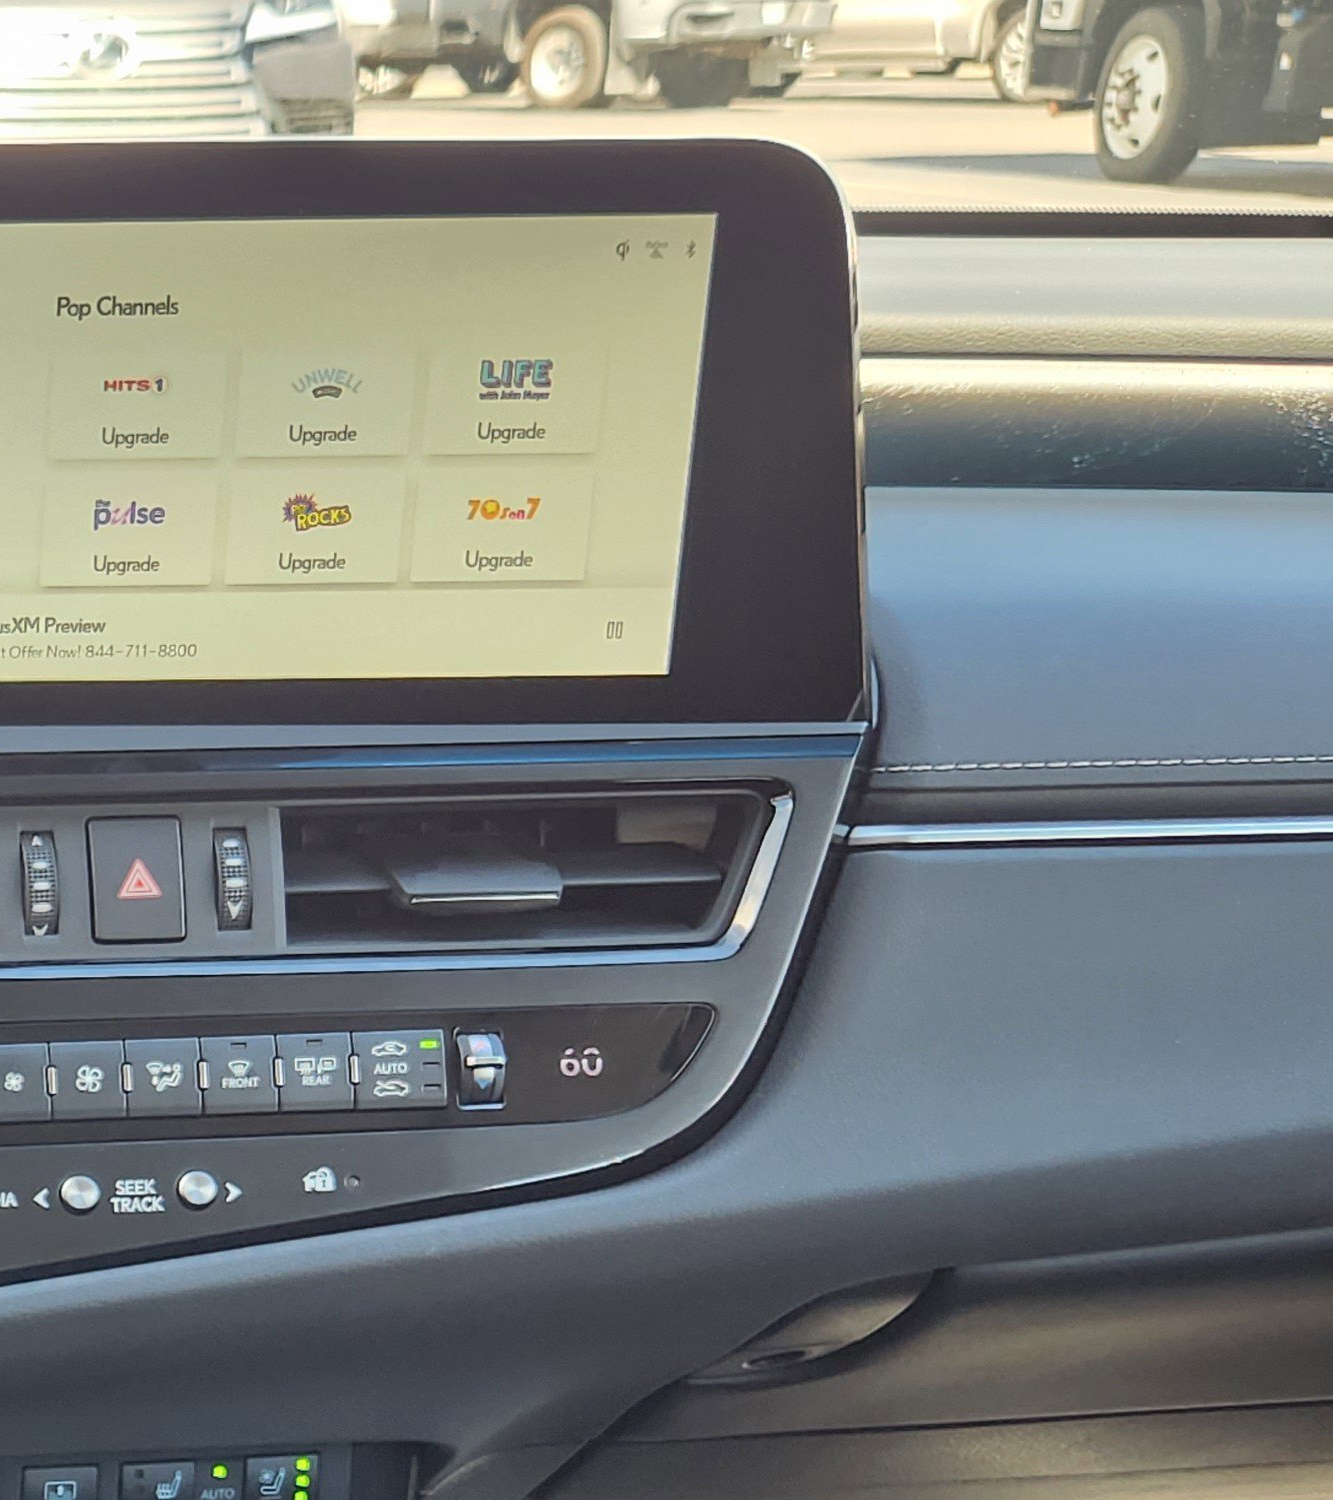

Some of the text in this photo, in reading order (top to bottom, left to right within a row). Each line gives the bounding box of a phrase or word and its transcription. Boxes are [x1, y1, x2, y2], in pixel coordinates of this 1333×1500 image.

[55, 295, 180, 321] Pop Channels
[290, 367, 364, 395] UNWELL
[479, 359, 554, 389] LIFE
[103, 379, 151, 392] HITS
[101, 427, 170, 449] Upgrade
[288, 424, 358, 446] Upgrade
[477, 421, 546, 444] Upgrade
[94, 501, 166, 530] pulse
[295, 505, 351, 531] ROCKS
[93, 555, 161, 578] Upgrade
[278, 552, 347, 575] Upgrade
[464, 550, 533, 572] Upgrade
[44, 617, 106, 634] Preview
[8, 645, 43, 660] Offer
[45, 644, 82, 659] Now!
[84, 643, 198, 659] 844-711-8800
[300, 1072, 331, 1087] REAR
[373, 1061, 408, 1076] AUTO
[221, 1075, 259, 1090] FRONT
[114, 1178, 157, 1197] SEEK
[110, 1196, 166, 1215] TRACK
